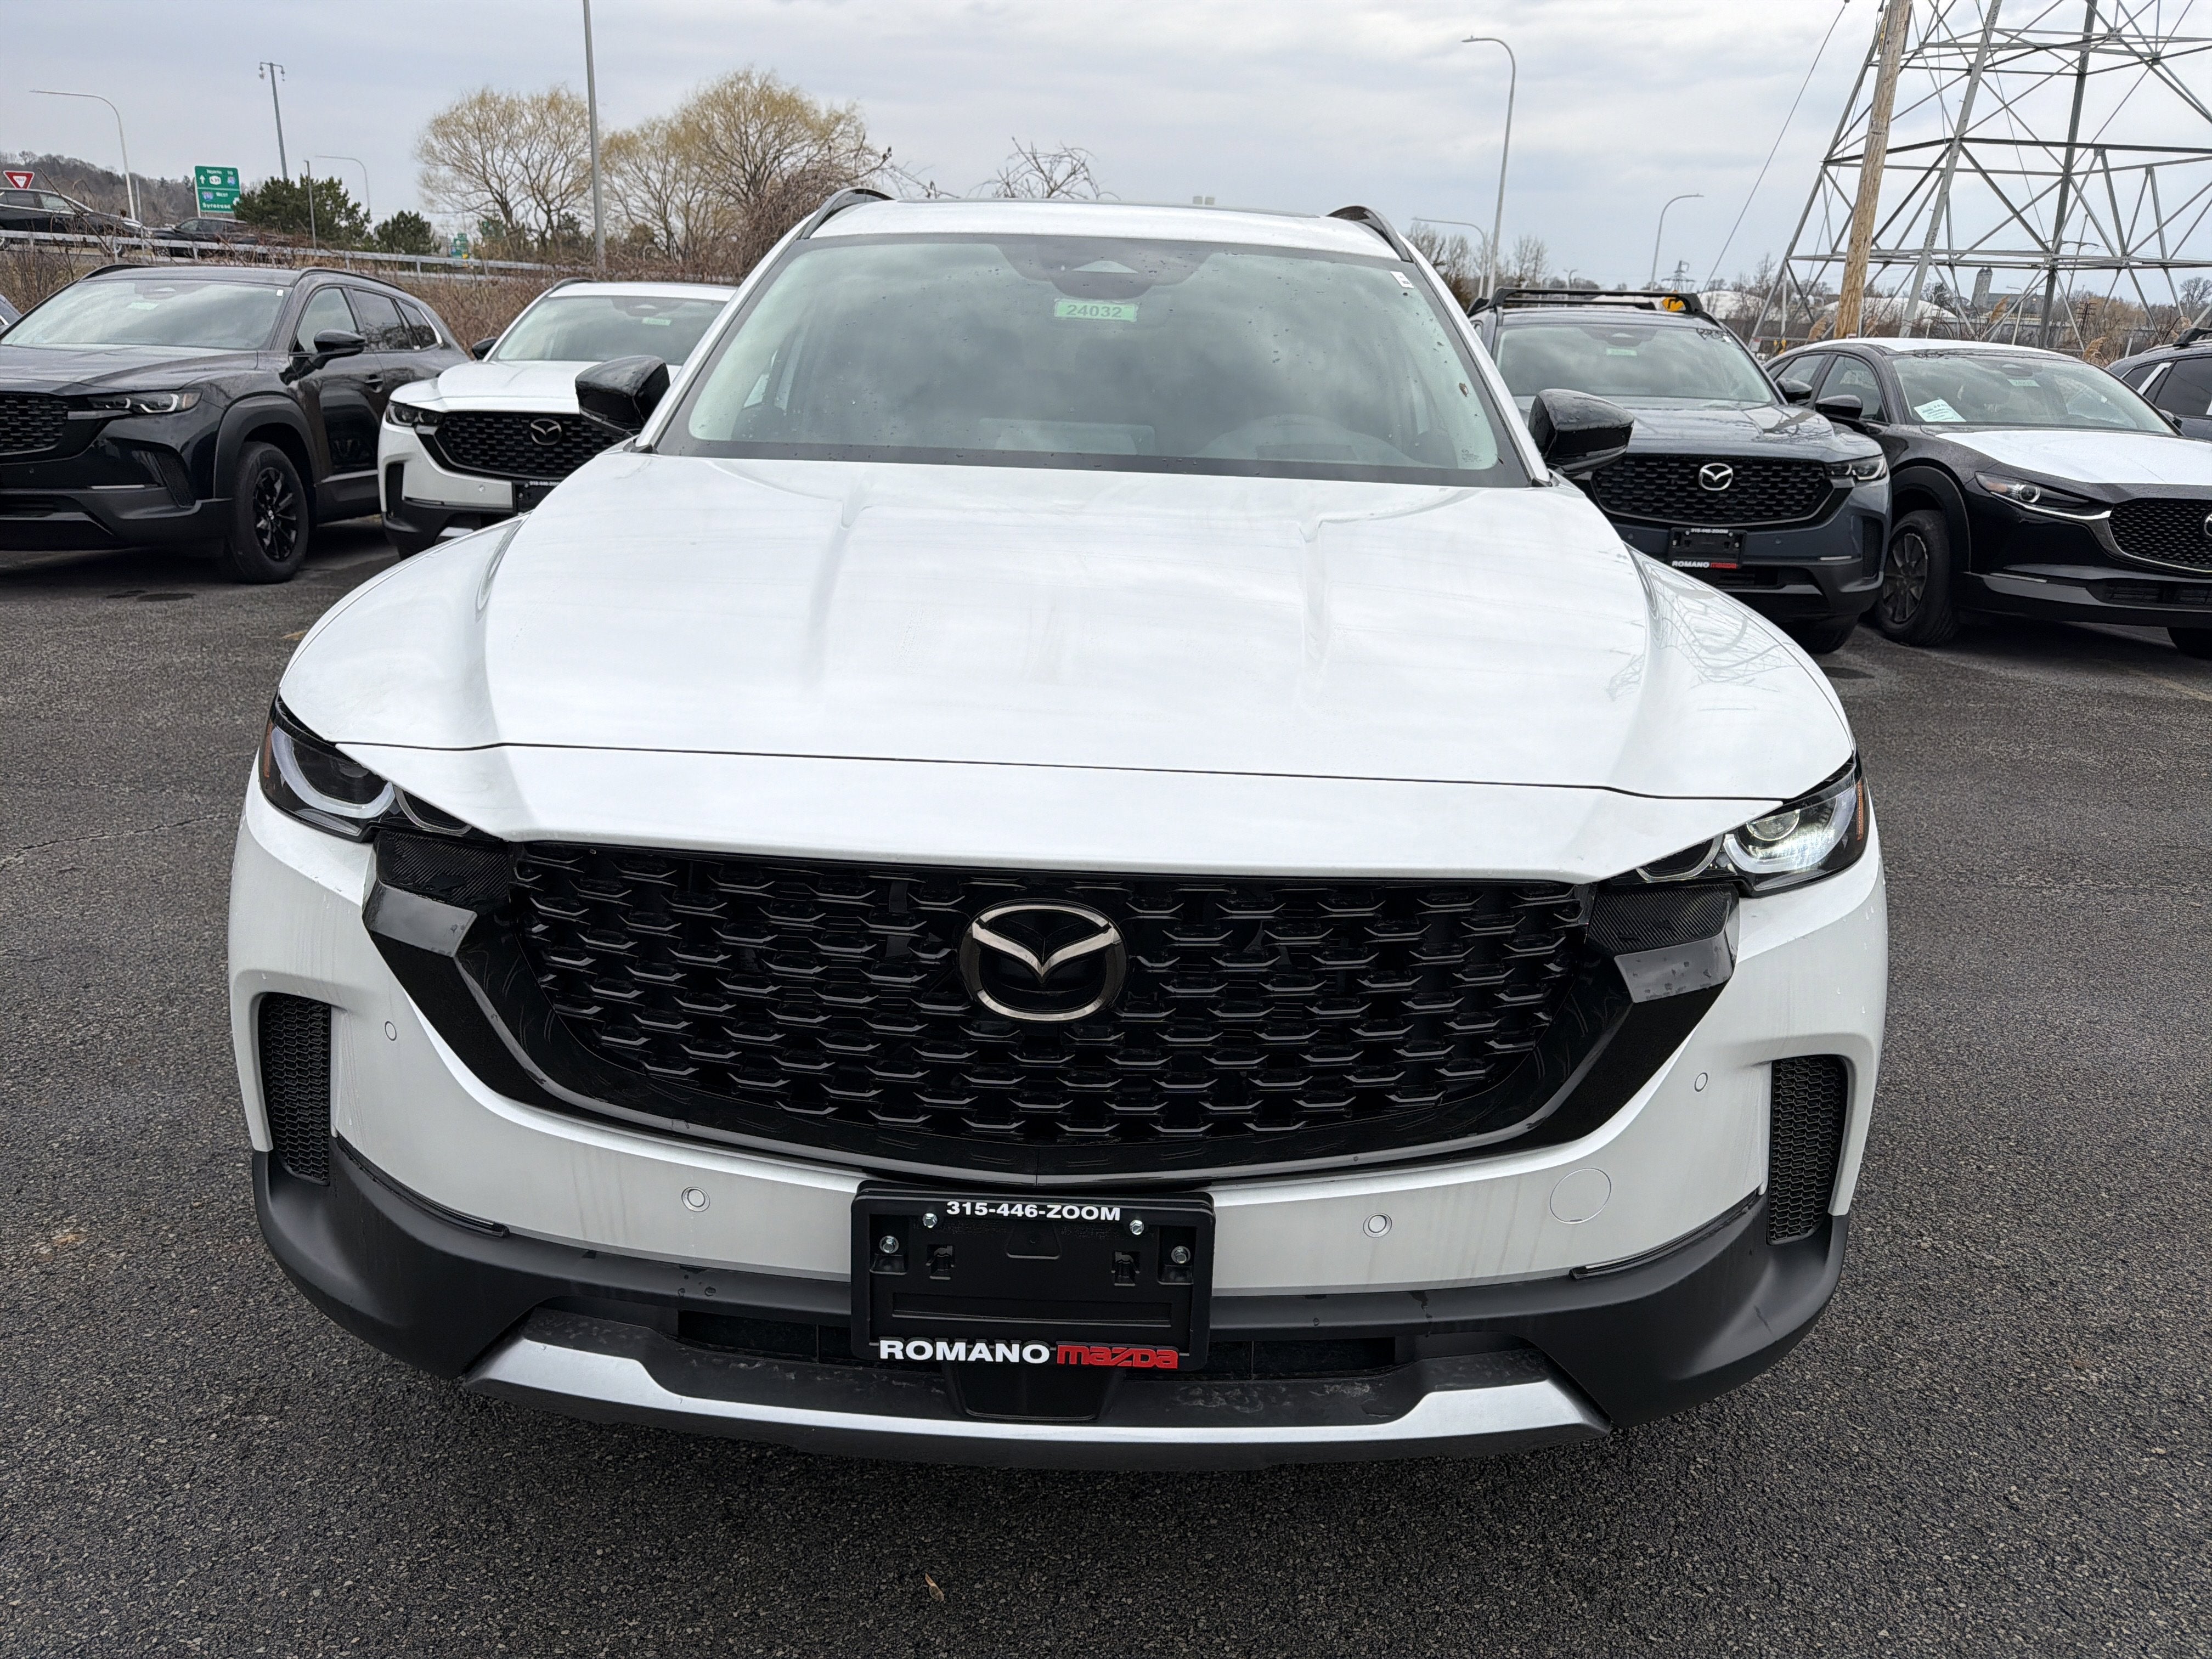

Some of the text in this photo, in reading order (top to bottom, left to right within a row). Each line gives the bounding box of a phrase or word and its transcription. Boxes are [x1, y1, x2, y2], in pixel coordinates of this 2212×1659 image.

[1066, 304, 1122, 318] 24032
[946, 1201, 1120, 1221] 315-446-ZOOM
[879, 1339, 1050, 1364] ROMANO
